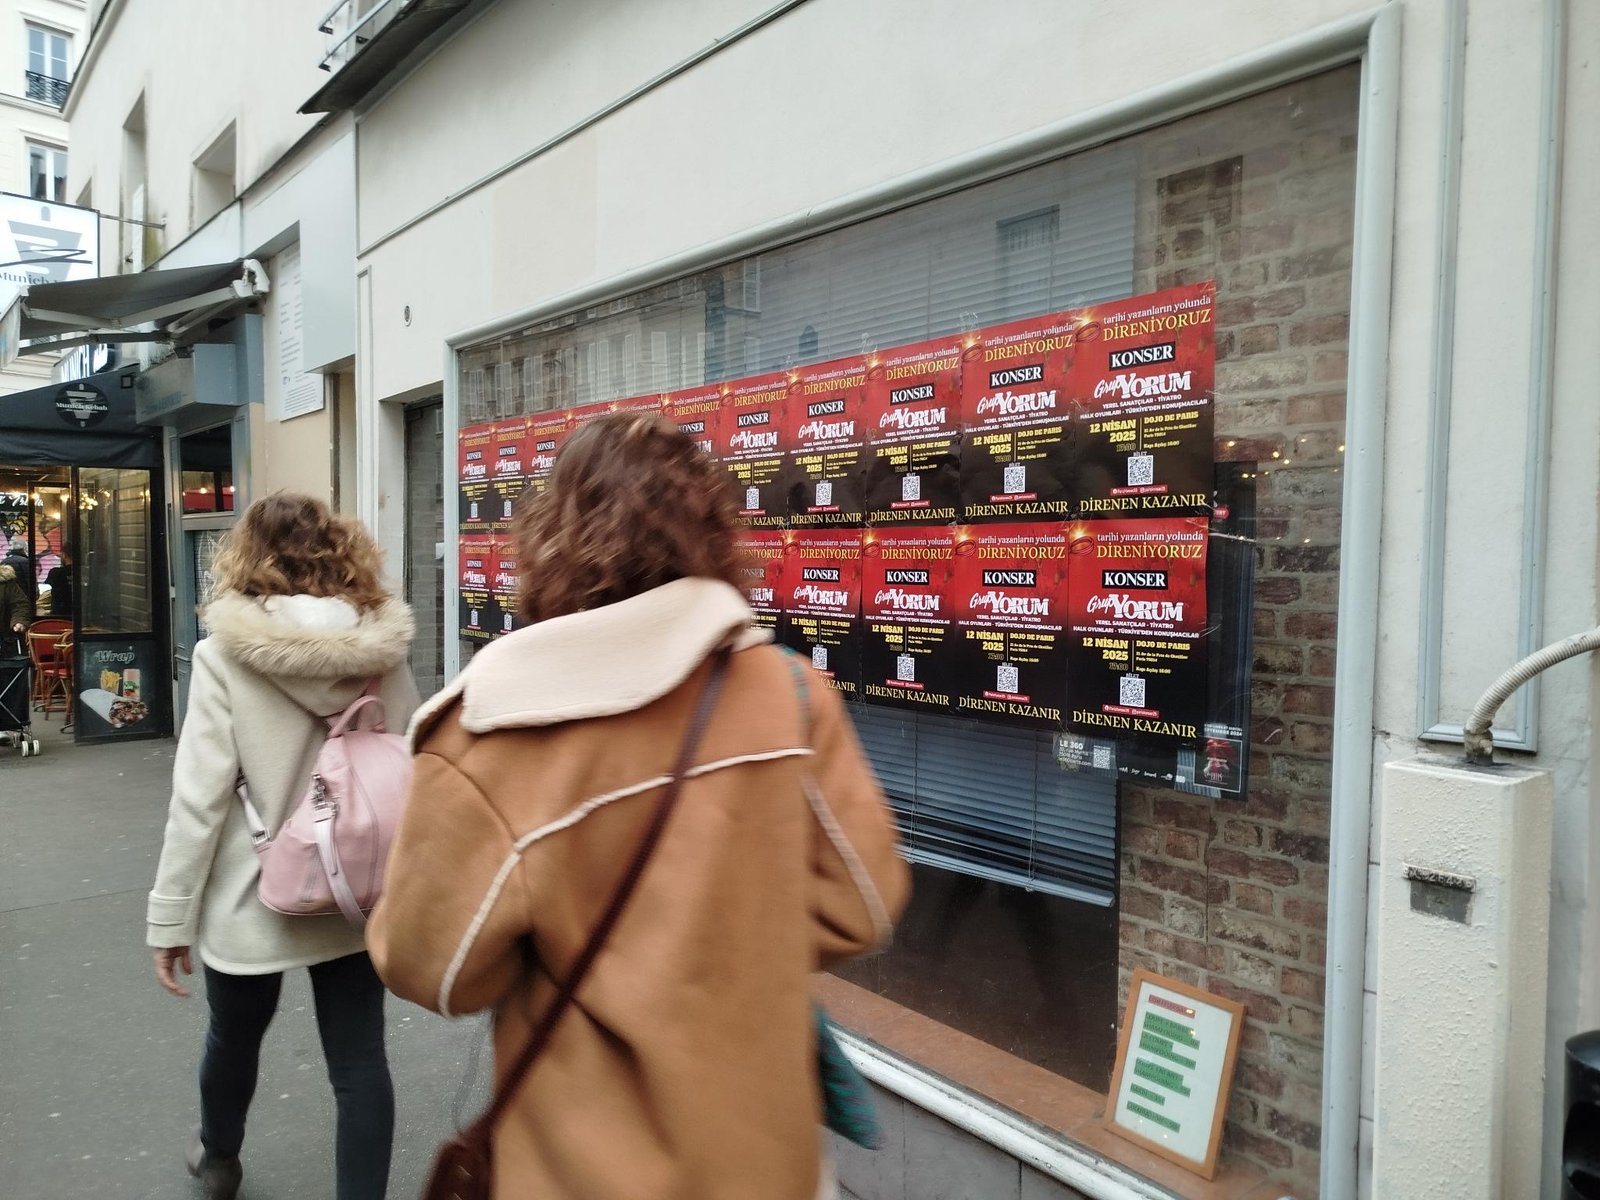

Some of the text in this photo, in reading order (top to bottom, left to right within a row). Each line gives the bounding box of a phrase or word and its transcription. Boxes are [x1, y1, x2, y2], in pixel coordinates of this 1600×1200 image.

[1173, 295, 1211, 312] yolunda
[1103, 310, 1210, 341] DİRENİYORUZ
[984, 335, 1072, 362] DİRENİYORUZ
[1111, 343, 1173, 368] KONSER
[991, 365, 1042, 386] KONSER
[1116, 370, 1191, 399] YORUM
[891, 384, 933, 403] KONSER
[56, 402, 84, 410] Munich
[995, 390, 1056, 414] YORUM
[894, 407, 945, 429] YORUM
[1144, 411, 1198, 424] DOJO DE PARIS
[1043, 426, 1062, 435] PARIS
[1089, 423, 1100, 433] 12
[1102, 419, 1135, 432] NİSAN
[973, 433, 1011, 445] 12 NİSAN
[1109, 430, 1135, 442] 2025
[989, 443, 1011, 454] 2025
[890, 455, 908, 465] 2025
[965, 500, 1068, 517] DİRENEN KAZANIR
[1080, 493, 1206, 512] DİRENEN KAZANIR
[912, 507, 955, 520] KAZANIR
[1166, 531, 1203, 542] yolunda
[977, 545, 1064, 558] DİRENİYORUZ
[1096, 543, 1202, 557] DİRENİYORUZ
[886, 570, 927, 582] KONSER
[984, 571, 1034, 584] KONSER
[1104, 572, 1166, 587] KONSER
[889, 588, 939, 610] YORUM
[988, 591, 1048, 615] YORUM
[1109, 594, 1183, 621] YORUM
[871, 624, 879, 632] 12
[885, 634, 902, 643] 2025
[966, 630, 1003, 641] 12 NİSAN
[1036, 634, 1054, 642] PARIS
[982, 641, 1003, 651] 2025
[1082, 636, 1128, 649] 12 NİSAN
[1136, 640, 1190, 651] DOJO DE PARIS
[95, 651, 135, 664] Wrap
[1102, 649, 1128, 661] 2025
[906, 690, 949, 705] KAZANIR
[958, 695, 1060, 721] DİRENEN KAZANIR
[1072, 709, 1129, 730] DİRENEN
[1133, 718, 1197, 739] KAZANIR
